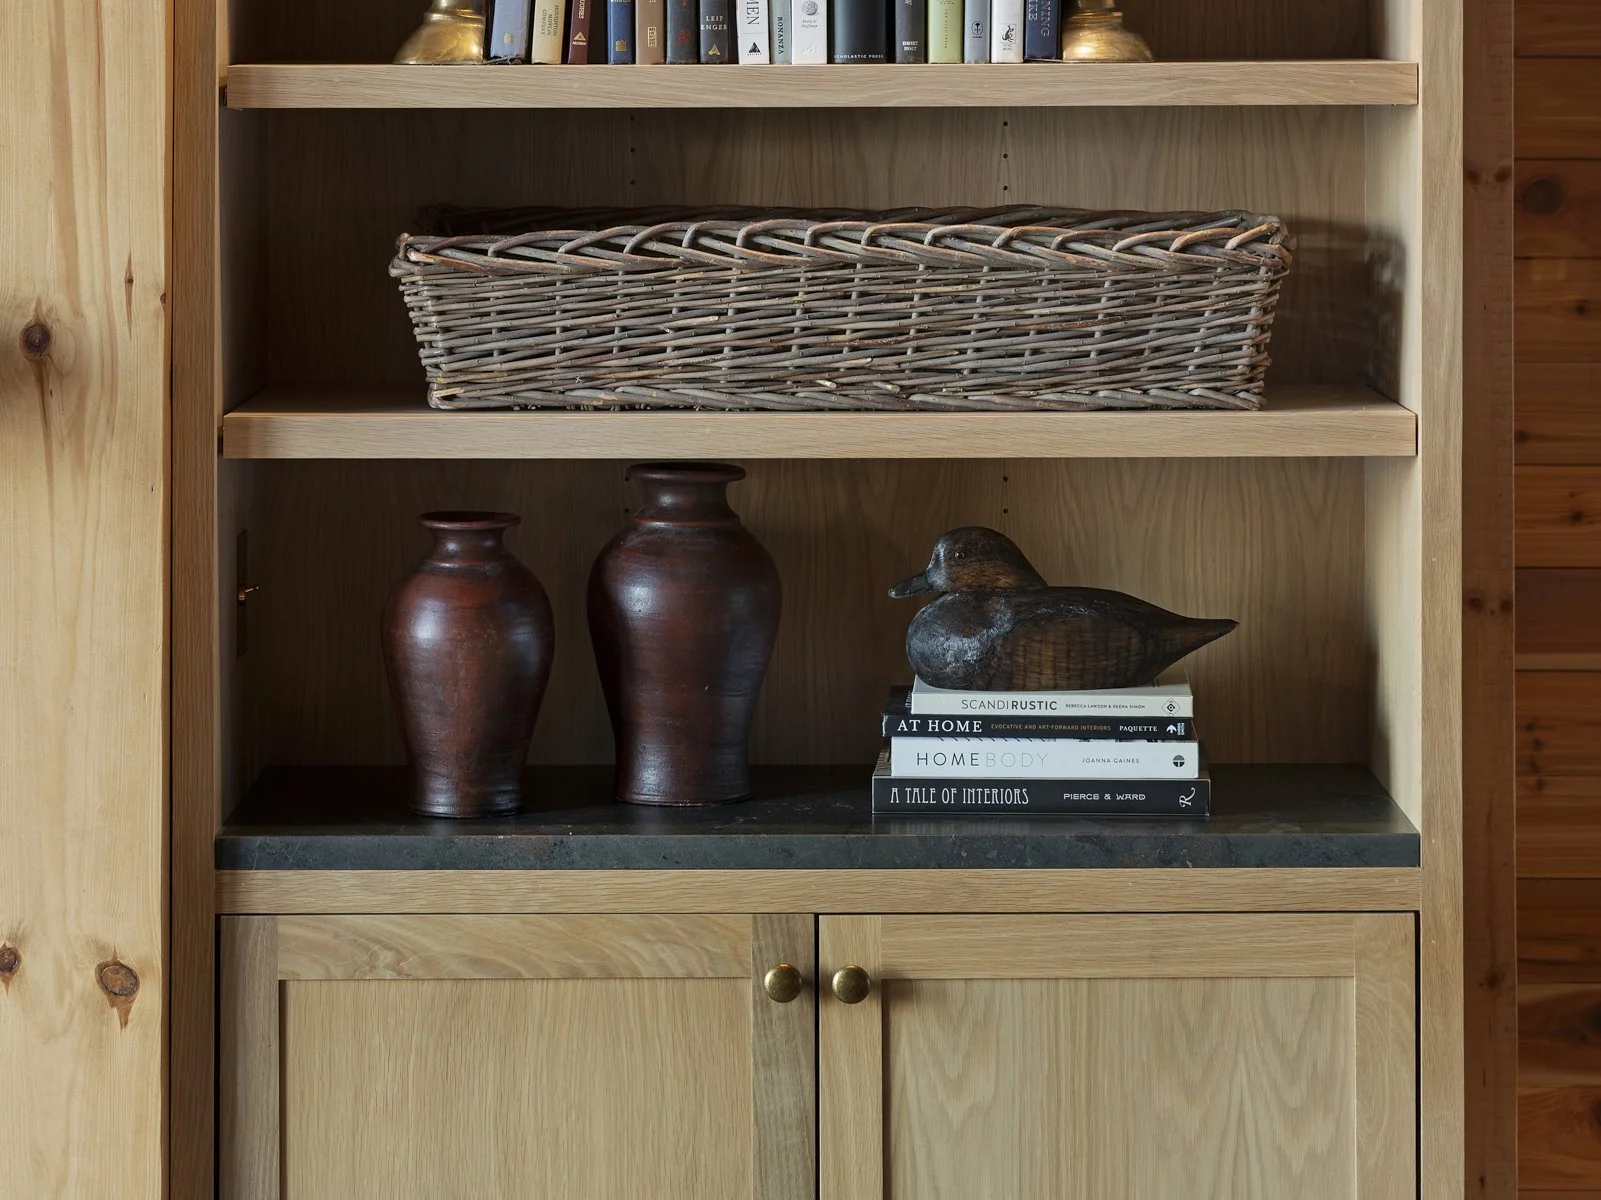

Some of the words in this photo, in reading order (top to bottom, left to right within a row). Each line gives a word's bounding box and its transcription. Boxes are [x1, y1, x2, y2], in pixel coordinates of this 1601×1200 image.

[552, 4, 560, 37] HOUGHTON
[777, 16, 785, 55] BONANZA
[961, 699, 1058, 710] SCANDIRUSTIC
[897, 719, 921, 732] AT
[927, 720, 982, 733] HOME
[916, 752, 1049, 768] HOMEBODY
[890, 787, 900, 804] A
[905, 787, 936, 804] TALE
[941, 788, 958, 804] OF
[962, 788, 1029, 805] INTERIORS
